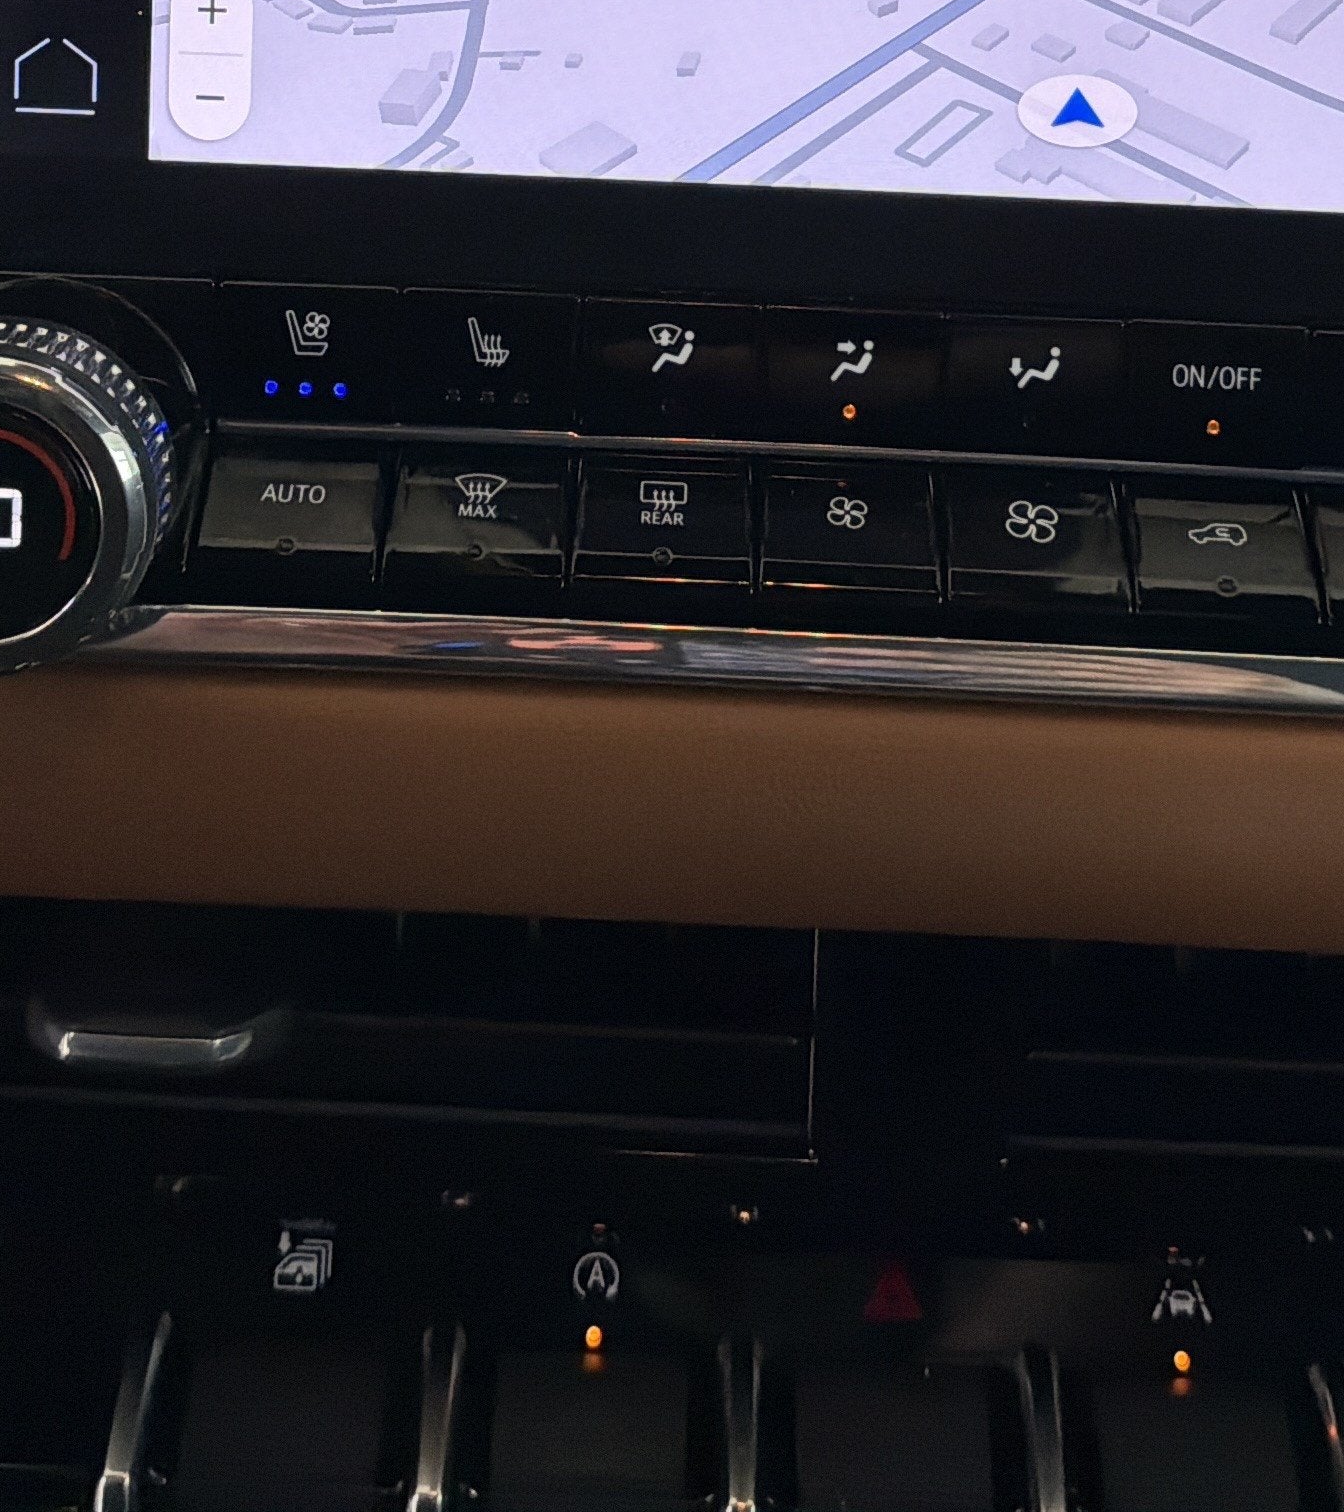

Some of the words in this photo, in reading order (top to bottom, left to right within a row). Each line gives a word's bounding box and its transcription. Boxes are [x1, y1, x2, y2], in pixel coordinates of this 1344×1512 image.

[1171, 362, 1263, 392] ON/OFF
[259, 482, 327, 505] AUTO
[457, 503, 498, 520] MAX
[640, 510, 685, 527] REAR
